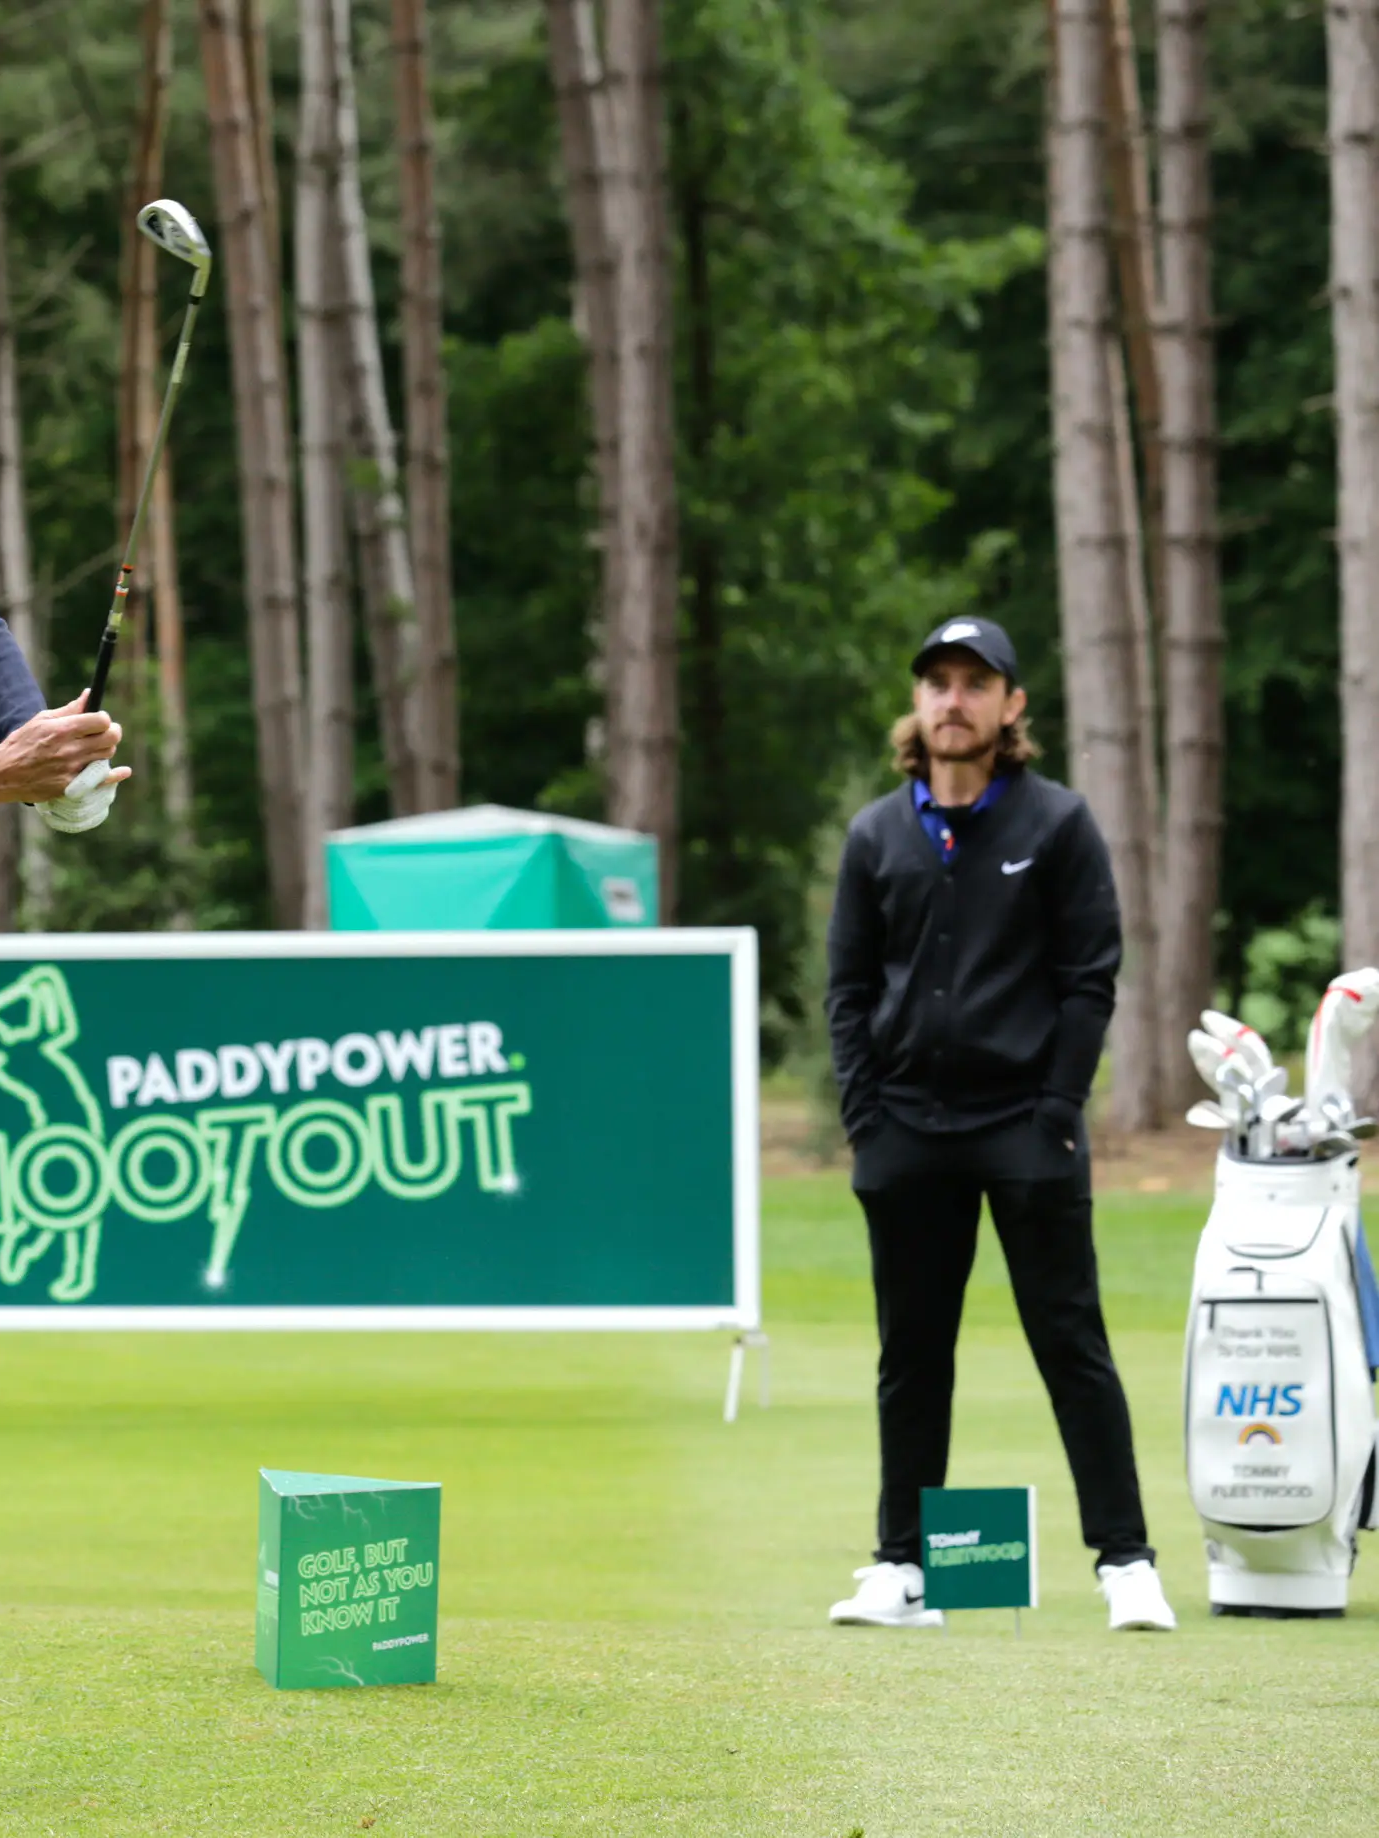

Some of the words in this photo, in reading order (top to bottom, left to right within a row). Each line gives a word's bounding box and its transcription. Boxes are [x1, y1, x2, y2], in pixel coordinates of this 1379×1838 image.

[1216, 1384, 1304, 1417] NHS
[1232, 1464, 1291, 1479] TOMMY
[1211, 1484, 1314, 1499] FLEETWOOD
[926, 1530, 981, 1549] TOMMY
[928, 1541, 1026, 1568] FLEETWOOD
[298, 1547, 362, 1580] GOLF,
[364, 1538, 409, 1568] BUT
[299, 1576, 350, 1608] NOT
[352, 1571, 381, 1598] AS
[382, 1561, 433, 1593] YOU
[301, 1600, 374, 1636] KNOW
[378, 1596, 401, 1623] IT
